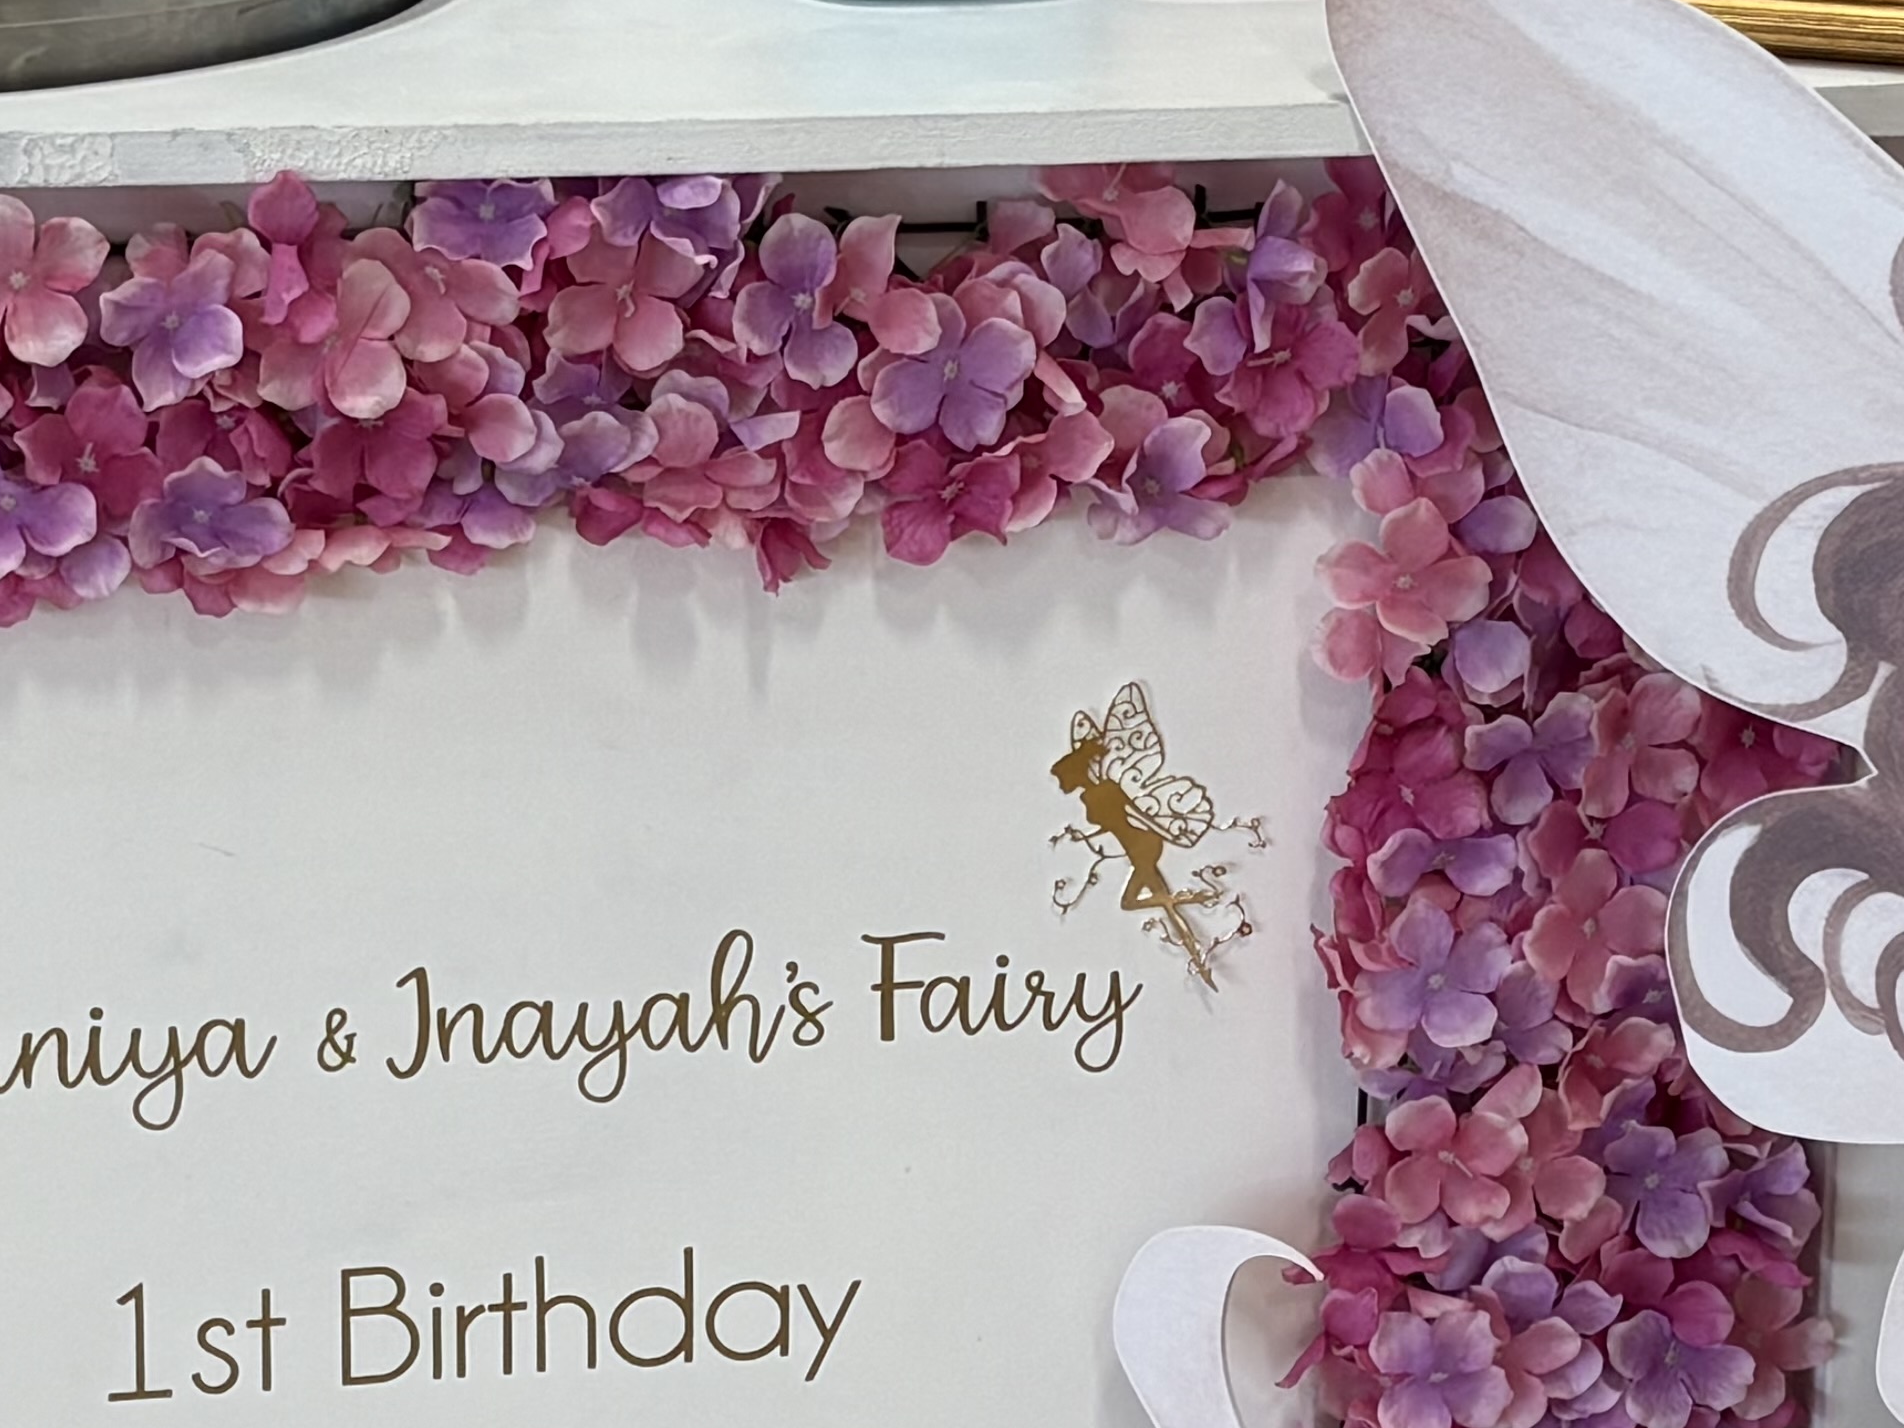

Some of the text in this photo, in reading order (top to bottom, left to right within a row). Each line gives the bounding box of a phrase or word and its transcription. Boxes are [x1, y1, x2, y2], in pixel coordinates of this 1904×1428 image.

[316, 1007, 359, 1072] &
[862, 930, 1143, 1072] Fairy
[107, 1245, 861, 1404] 1st Birthday
